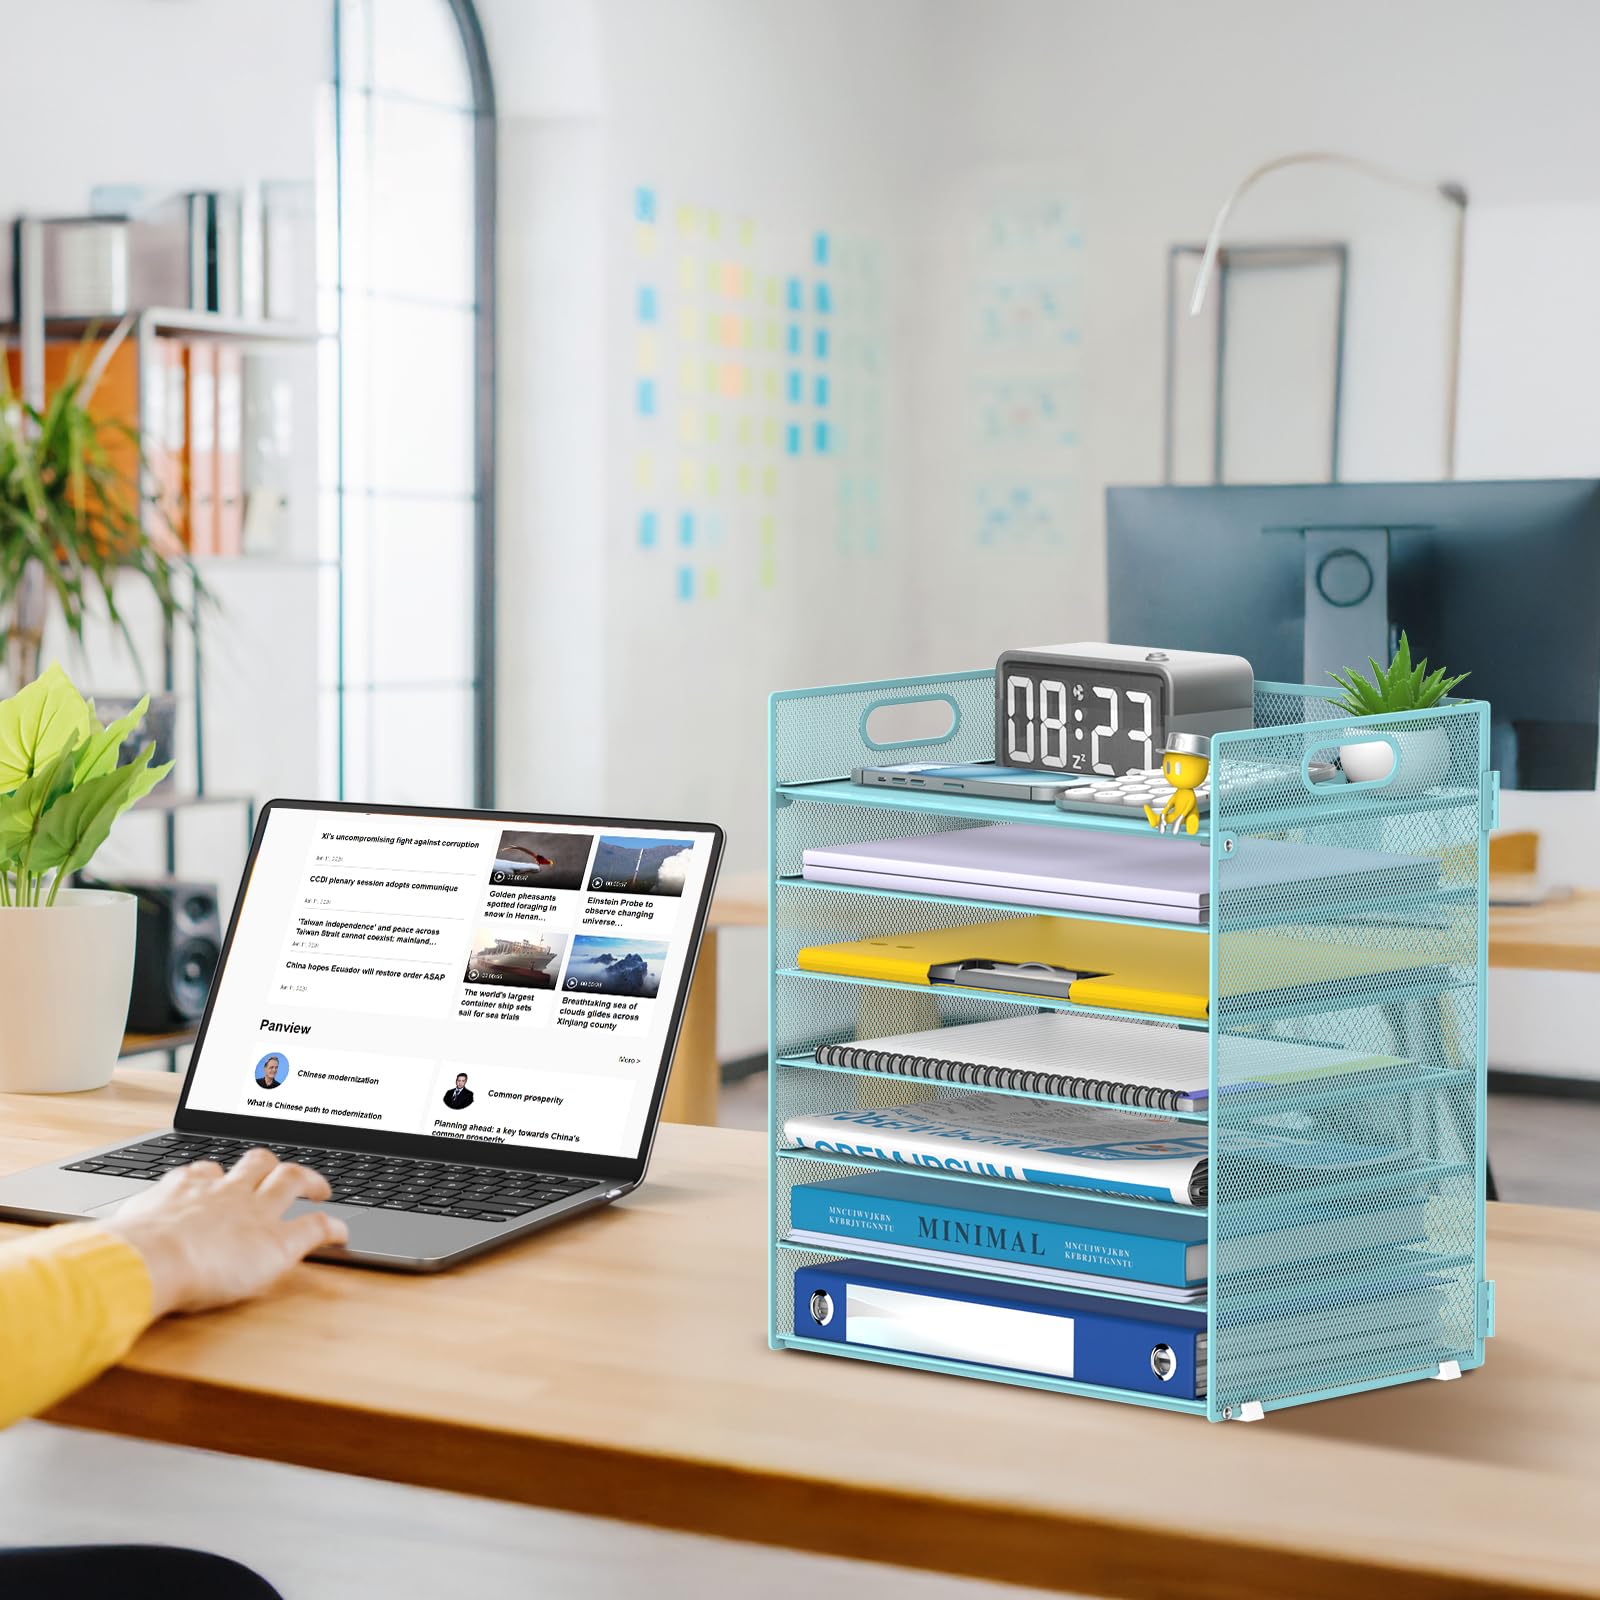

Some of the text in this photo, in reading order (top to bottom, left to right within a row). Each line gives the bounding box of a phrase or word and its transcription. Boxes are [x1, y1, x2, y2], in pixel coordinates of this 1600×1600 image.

[1008, 676, 1152, 776] 08:23
[321, 832, 480, 849] Xi's uncompromising fight against corruption
[309, 875, 459, 893] CCDI plenary session adopts communique
[489, 890, 557, 902] Golden pheasants
[587, 896, 619, 906] Einstein
[619, 898, 644, 908] Probe
[486, 901, 557, 913] spotted foraging in
[584, 907, 655, 920] observe changing
[505, 911, 514, 919] in
[296, 927, 320, 937] Taiwan
[320, 929, 341, 938] Strait
[341, 932, 366, 940] cannot
[391, 926, 414, 934] peace
[414, 928, 440, 936] across
[285, 960, 446, 981] China hopes Ecuador will restore order ASAP
[464, 988, 535, 1003] The world's largest
[561, 996, 639, 1010] Breathtaking sea of
[460, 999, 532, 1012] container ship sets
[458, 1009, 472, 1017] sail
[473, 1009, 485, 1018] for
[500, 1012, 520, 1021] trials
[559, 1007, 640, 1021] clouds glides across
[259, 1018, 312, 1035] Panview
[556, 1017, 618, 1032] Xinjiang county
[297, 1069, 380, 1085] Chinese modernization
[487, 1089, 564, 1106] Common prosperity
[247, 1098, 266, 1108] What
[274, 1101, 304, 1112] Chinese
[303, 1105, 321, 1114] path
[321, 1107, 330, 1115] to
[330, 1109, 383, 1120] modernization
[433, 1119, 468, 1132] Planning
[502, 1126, 517, 1137] key
[518, 1128, 550, 1139] towards
[550, 1132, 580, 1143] China's
[918, 1216, 1046, 1255] MINIMAL
